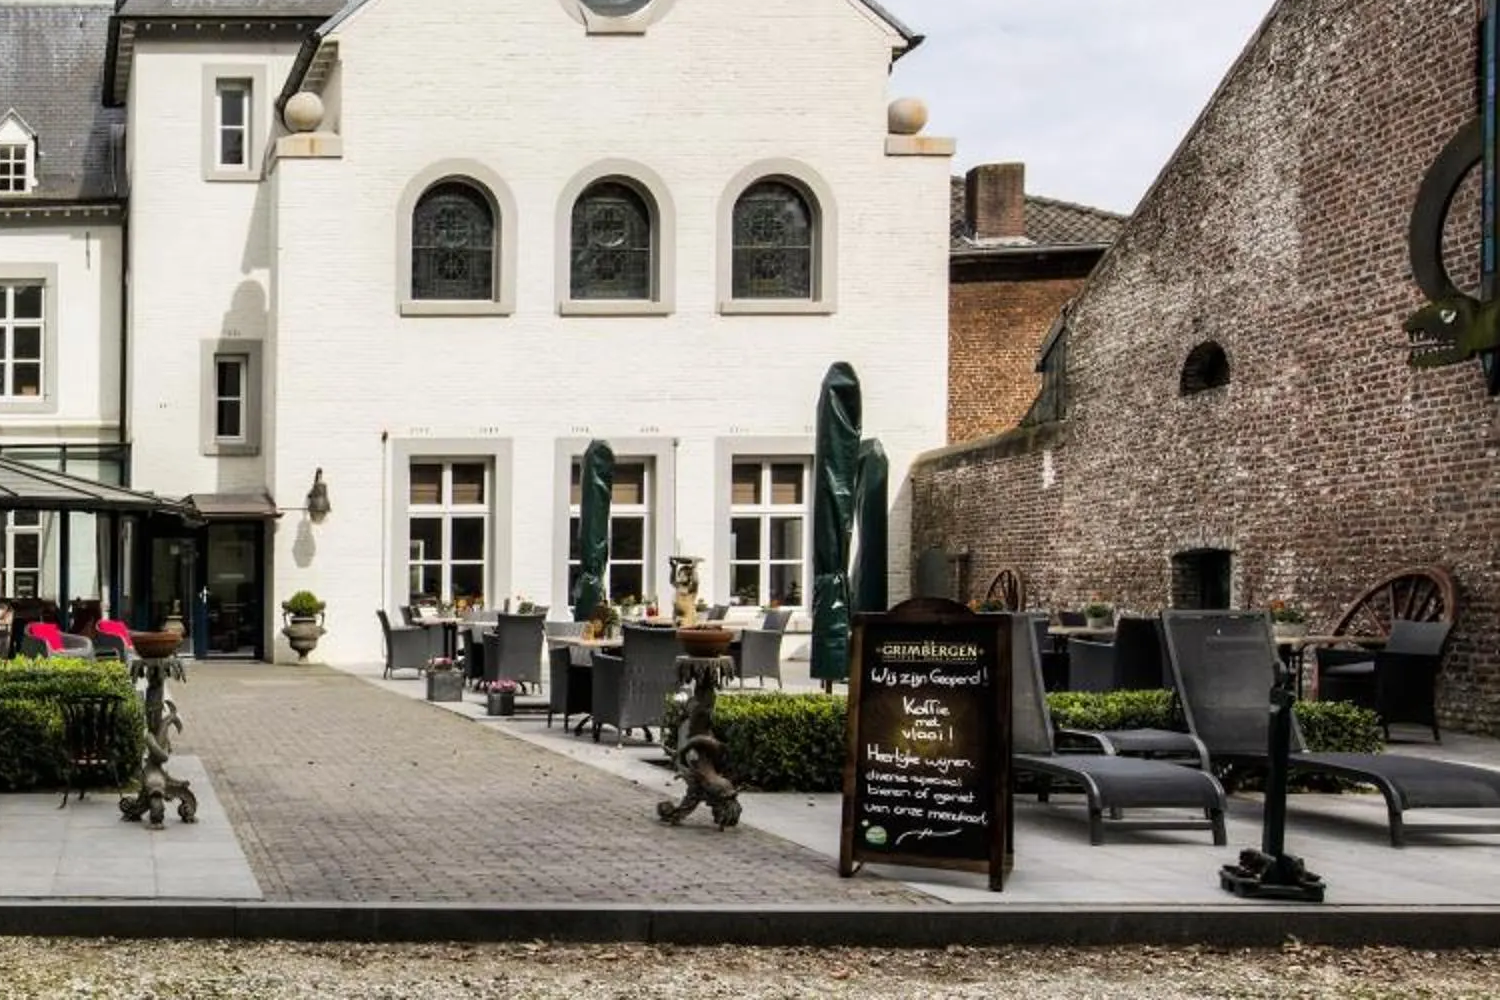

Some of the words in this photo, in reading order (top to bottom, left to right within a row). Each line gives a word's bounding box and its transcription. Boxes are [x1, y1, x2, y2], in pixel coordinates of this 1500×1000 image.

[882, 644, 977, 657] GRIMBERGEN
[871, 667, 897, 686] Wij
[900, 672, 927, 688] zijn
[903, 696, 950, 716] Koffie
[915, 717, 940, 727] met
[914, 787, 930, 799] of
[933, 792, 976, 805] geniet
[863, 803, 891, 814] van
[893, 806, 924, 817] onze
